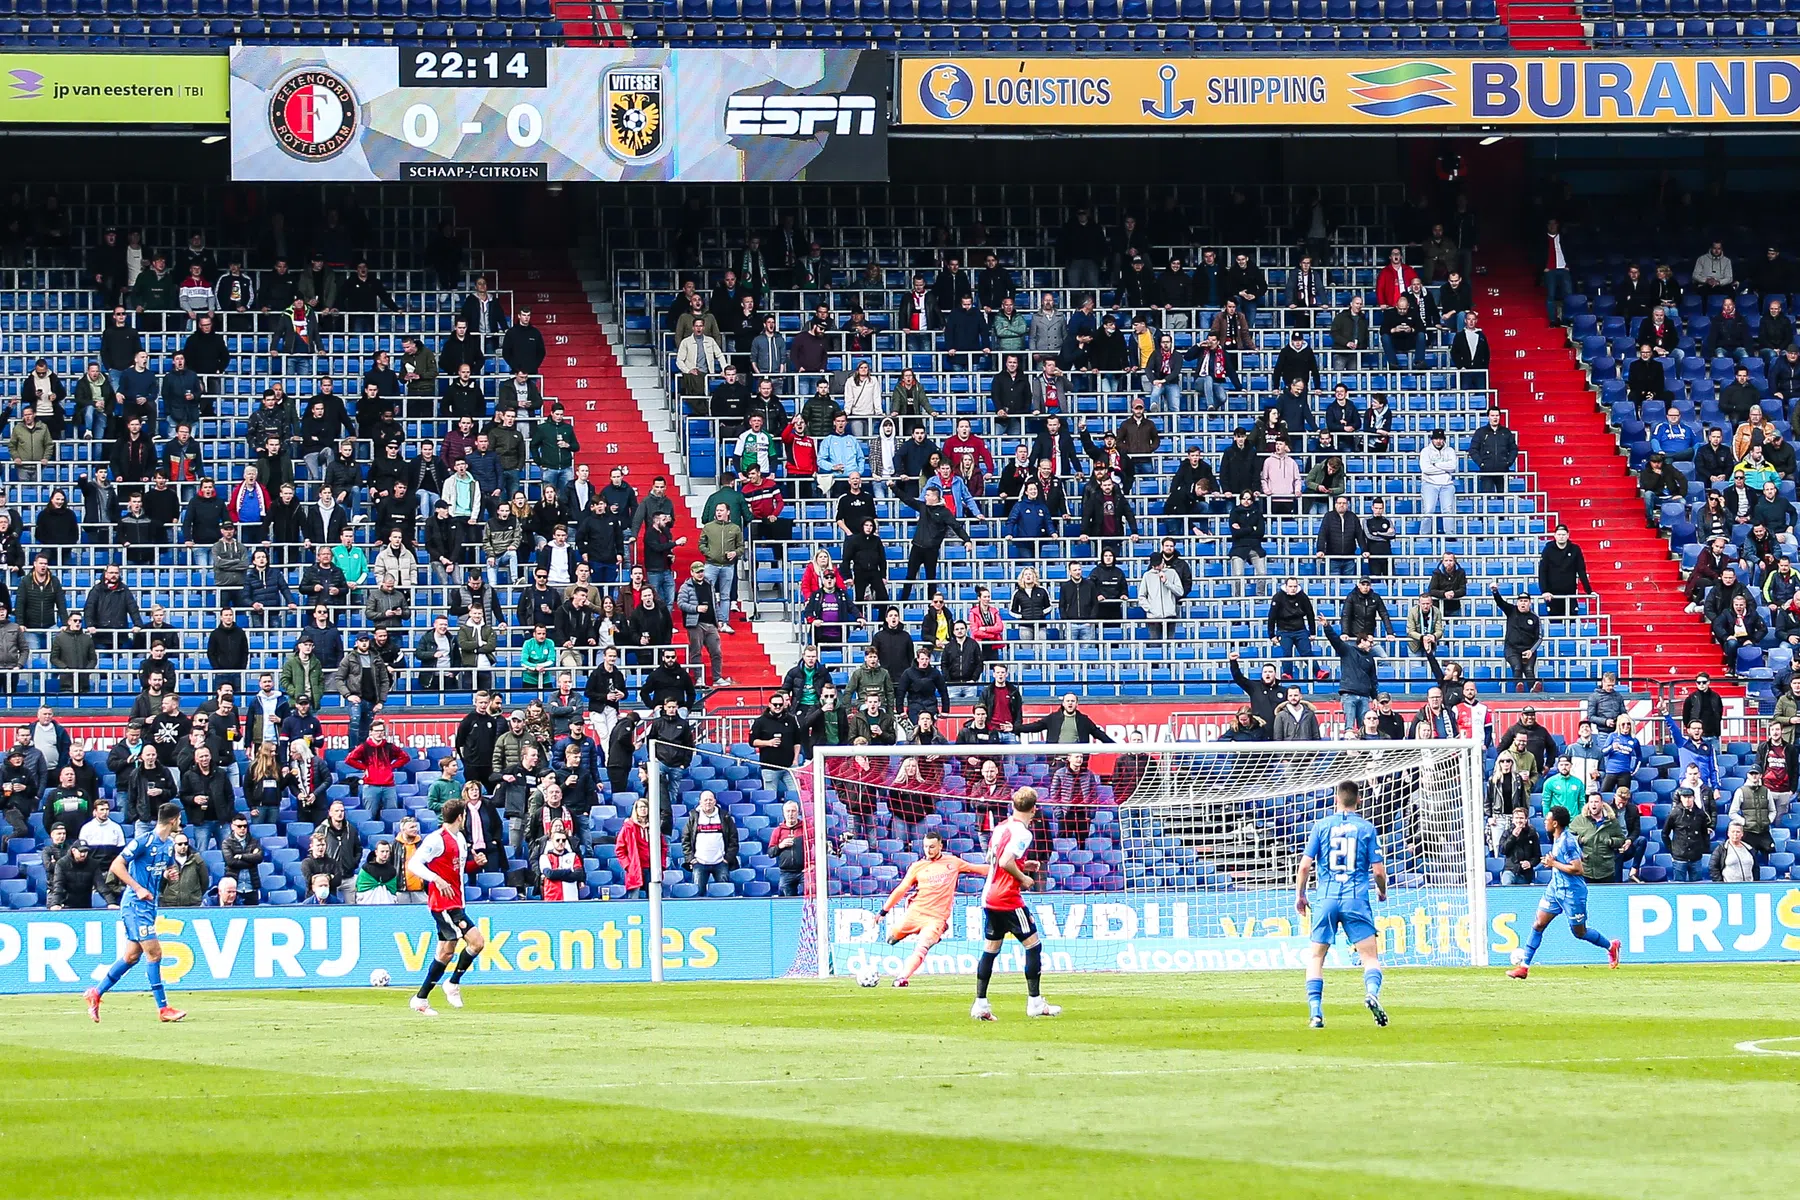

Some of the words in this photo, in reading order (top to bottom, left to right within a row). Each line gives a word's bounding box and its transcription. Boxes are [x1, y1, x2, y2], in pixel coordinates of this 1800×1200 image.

[415, 51, 529, 79] 22:14
[611, 74, 658, 90] VITESSE
[53, 83, 70, 99] jp
[72, 86, 101, 97] van
[103, 84, 173, 97] eesteren
[185, 86, 204, 96] TBI
[276, 74, 350, 103] FEYENOORD
[984, 77, 1112, 106] LOGISTICS
[1207, 76, 1326, 105] SHIPPING
[1470, 62, 1800, 118] BURAND
[726, 95, 876, 135] ESPN
[401, 103, 440, 148] 0
[506, 103, 543, 148] 0
[277, 124, 352, 154] ROTTERDAM
[409, 165, 465, 178] SCHAAP
[479, 165, 539, 178] CITROEN
[545, 314, 556, 323] 21
[1504, 329, 1517, 337] 20
[555, 335, 569, 345] 20
[566, 356, 577, 366] 19
[1523, 371, 1535, 380] 18
[575, 378, 588, 389] 18
[1534, 392, 1545, 400] 17
[585, 400, 597, 411] 17
[595, 422, 608, 433] 16
[605, 443, 618, 454] 15
[1580, 498, 1591, 507] 12
[1614, 561, 1622, 570] 9
[1625, 582, 1633, 590] 8
[736, 697, 744, 706] 3
[1329, 836, 1357, 873] 21
[393, 914, 720, 973] vkanties
